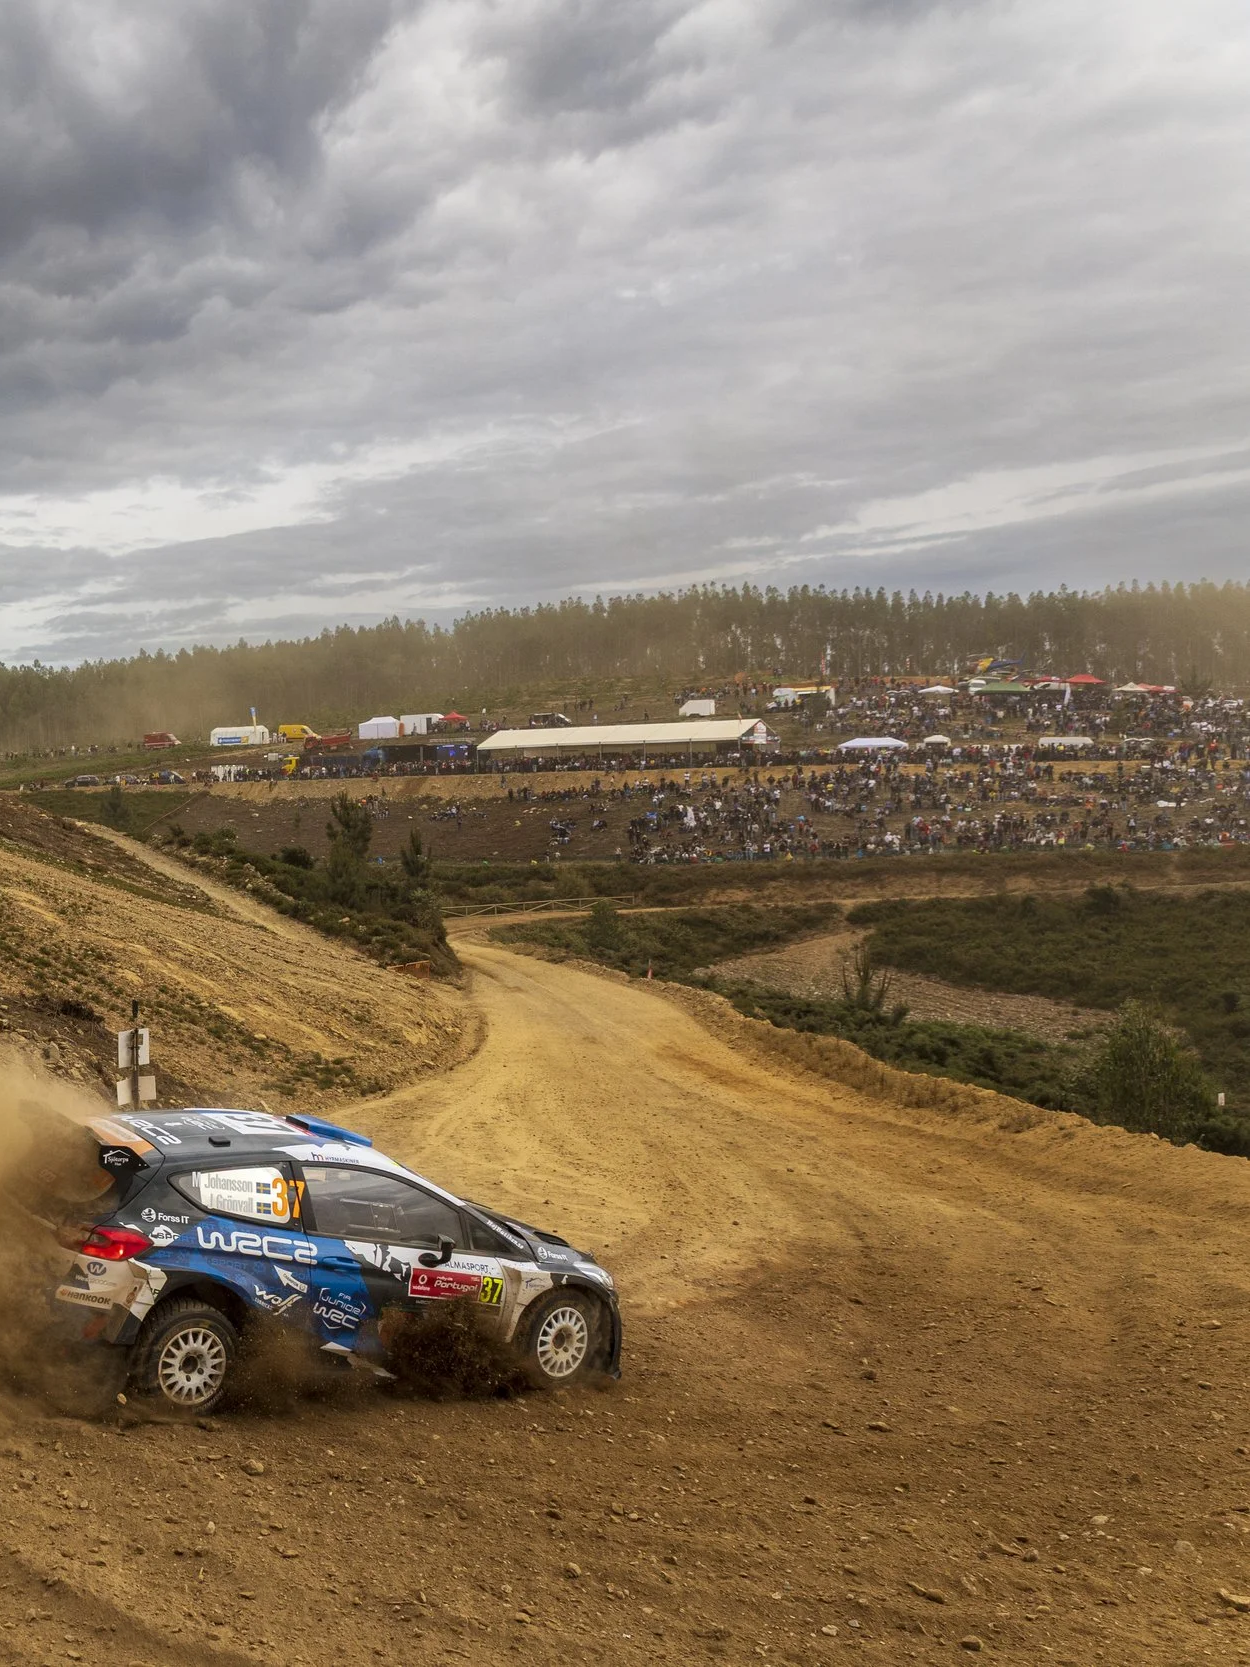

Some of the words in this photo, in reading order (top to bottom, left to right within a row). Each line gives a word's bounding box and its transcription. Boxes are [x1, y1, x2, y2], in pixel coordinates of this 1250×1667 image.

[192, 1171, 201, 1188] M
[204, 1173, 253, 1193] Johansson
[216, 1194, 254, 1213] Grönvall
[271, 1177, 305, 1219] 37
[158, 1212, 180, 1223] Forss
[181, 1215, 190, 1224] IT
[196, 1226, 318, 1265] WRC2
[434, 1279, 478, 1292] Portugal
[479, 1276, 503, 1304] 37
[313, 1302, 359, 1329] WRC
